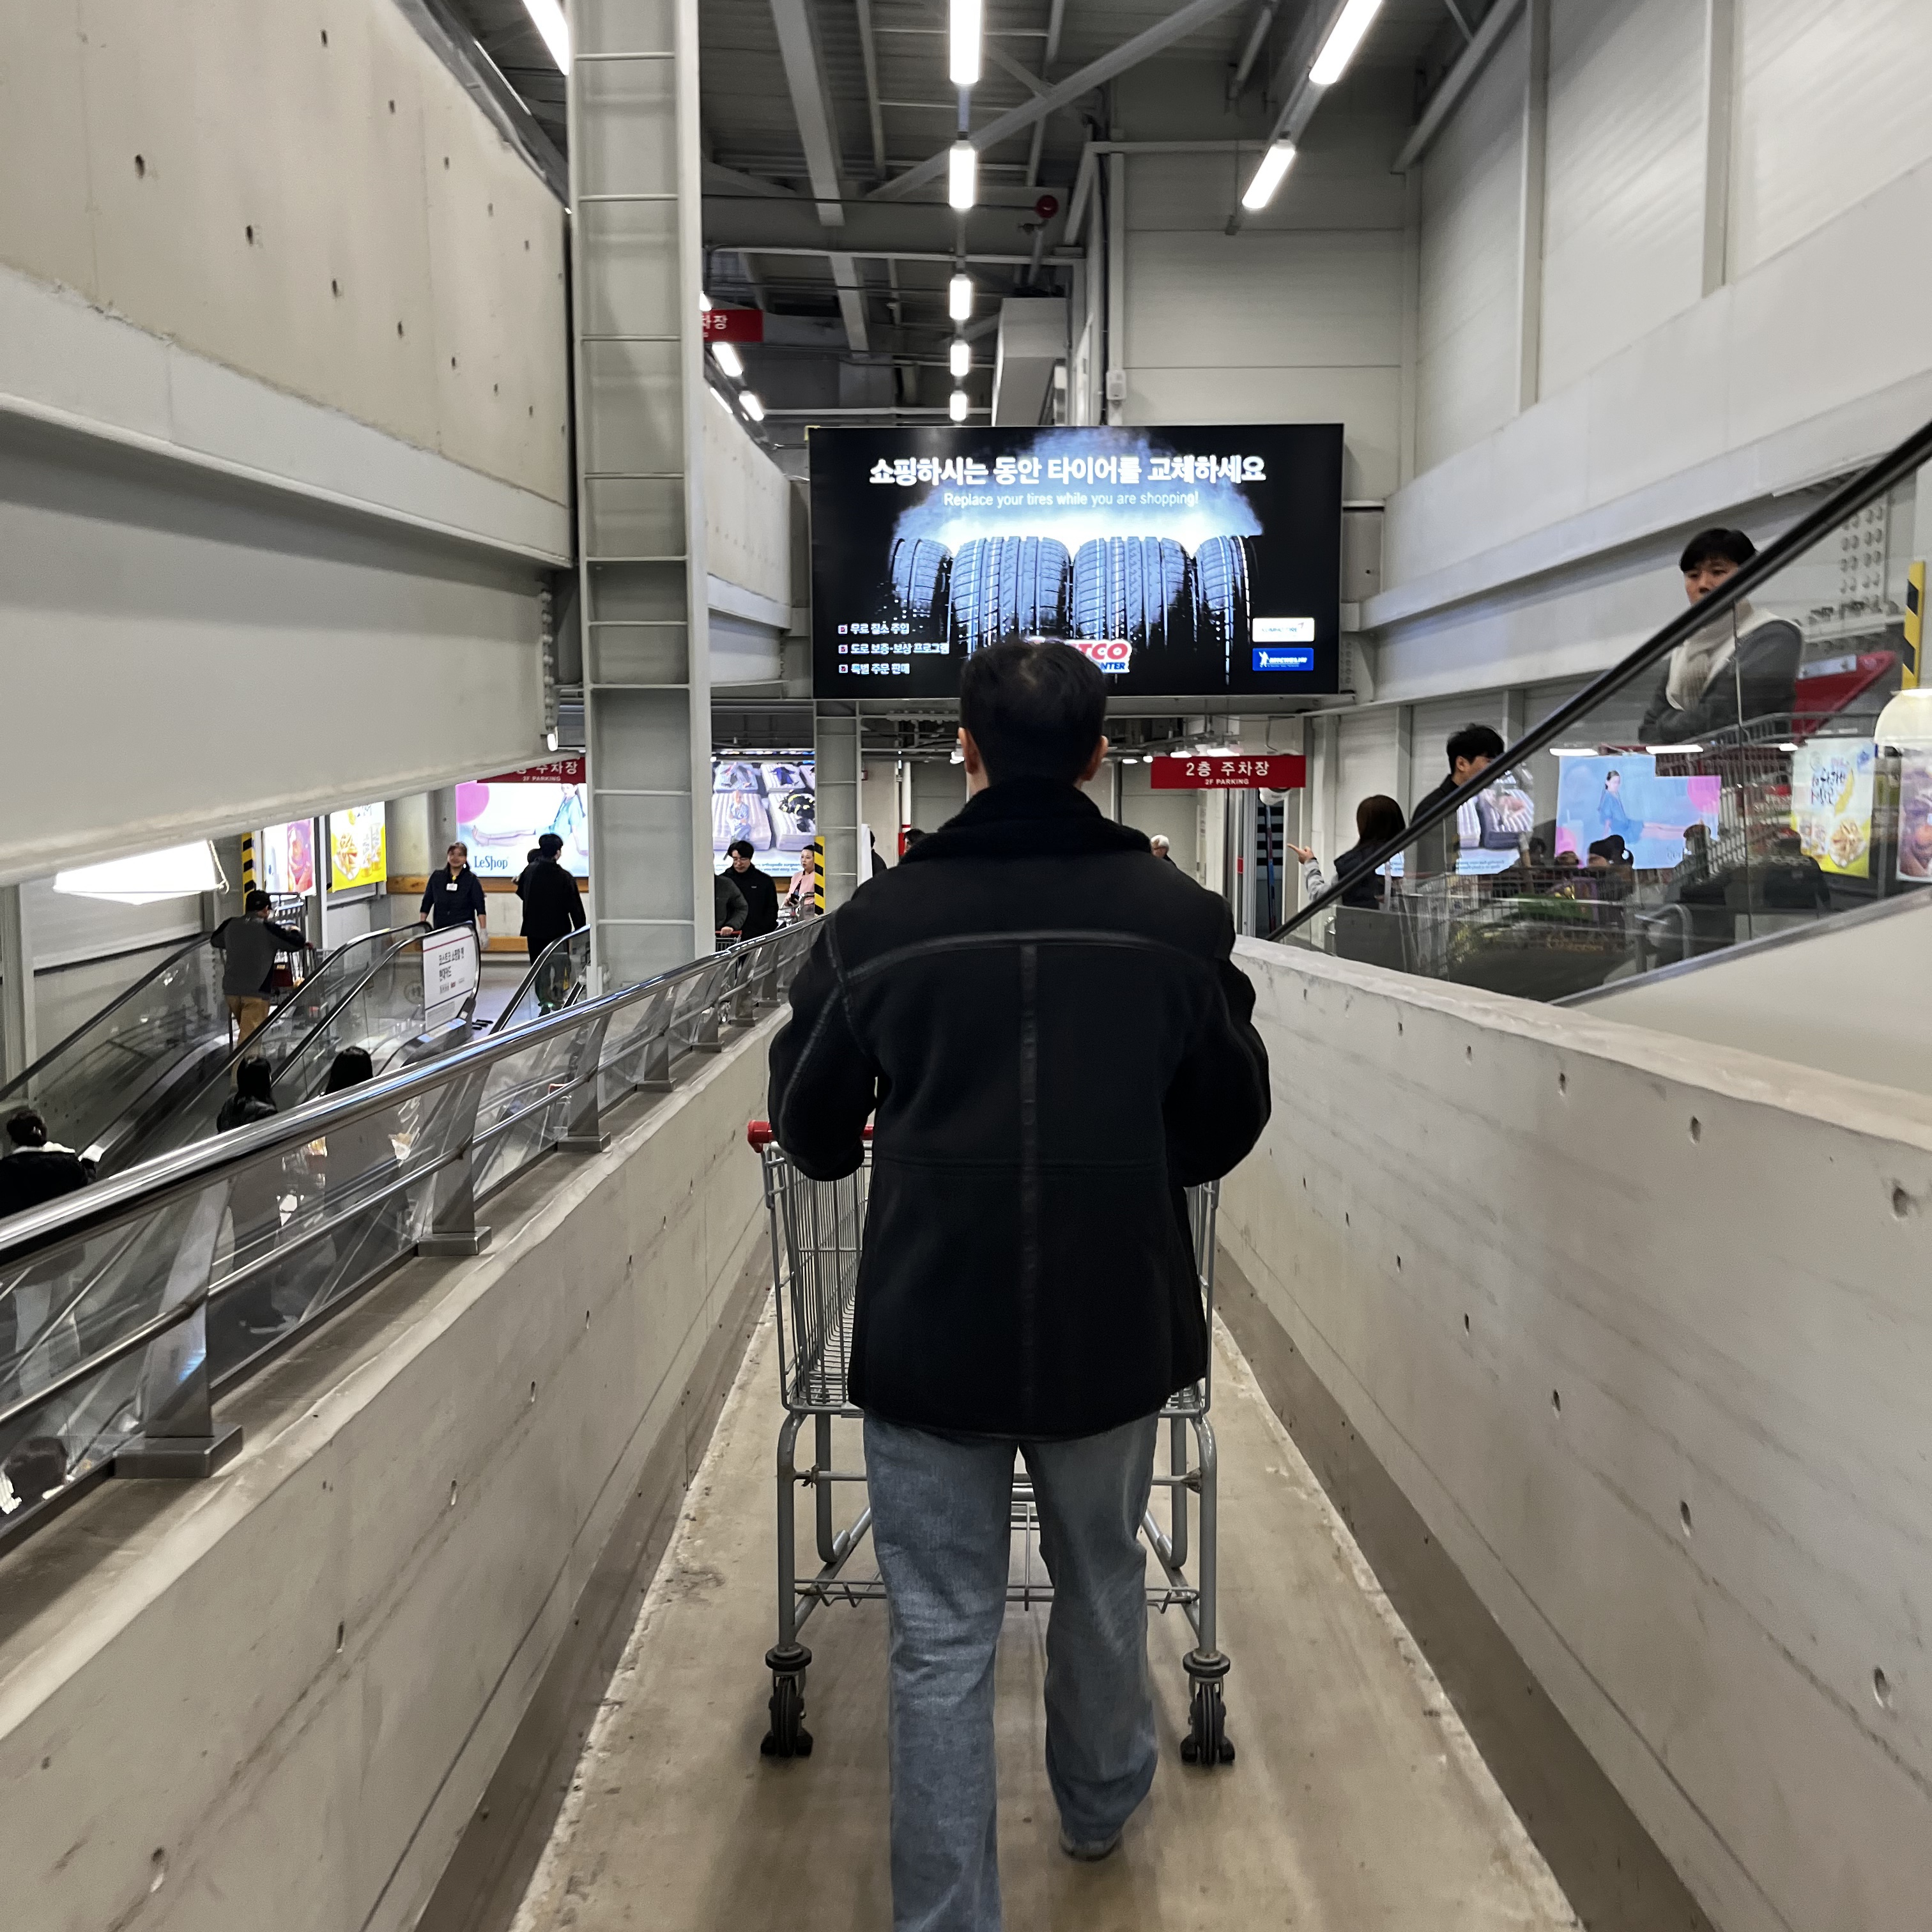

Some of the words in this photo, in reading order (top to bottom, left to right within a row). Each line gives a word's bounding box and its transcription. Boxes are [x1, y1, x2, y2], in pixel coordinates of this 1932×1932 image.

[869, 456, 989, 486] 쇼핑하시는
[993, 456, 1043, 485] 동안
[1047, 456, 1142, 485] 타이어를
[1147, 454, 1266, 484] 교체하세요
[944, 492, 993, 509] Replace
[997, 494, 1023, 509] your
[1027, 492, 1054, 505] tires
[1057, 492, 1088, 505] while
[1091, 494, 1113, 507] you
[1117, 494, 1136, 505] are
[1140, 491, 1199, 507] shopping!
[850, 623, 870, 634] 무료
[891, 623, 910, 634] 주입
[850, 643, 870, 654] 도로
[913, 642, 950, 655] 프로그램
[1070, 643, 1128, 660] TCO
[871, 663, 890, 674] 주문
[1100, 662, 1126, 670] NTER
[1186, 761, 1211, 777] 2층
[1220, 760, 1269, 776] 주차장
[474, 855, 508, 870] LeShop
